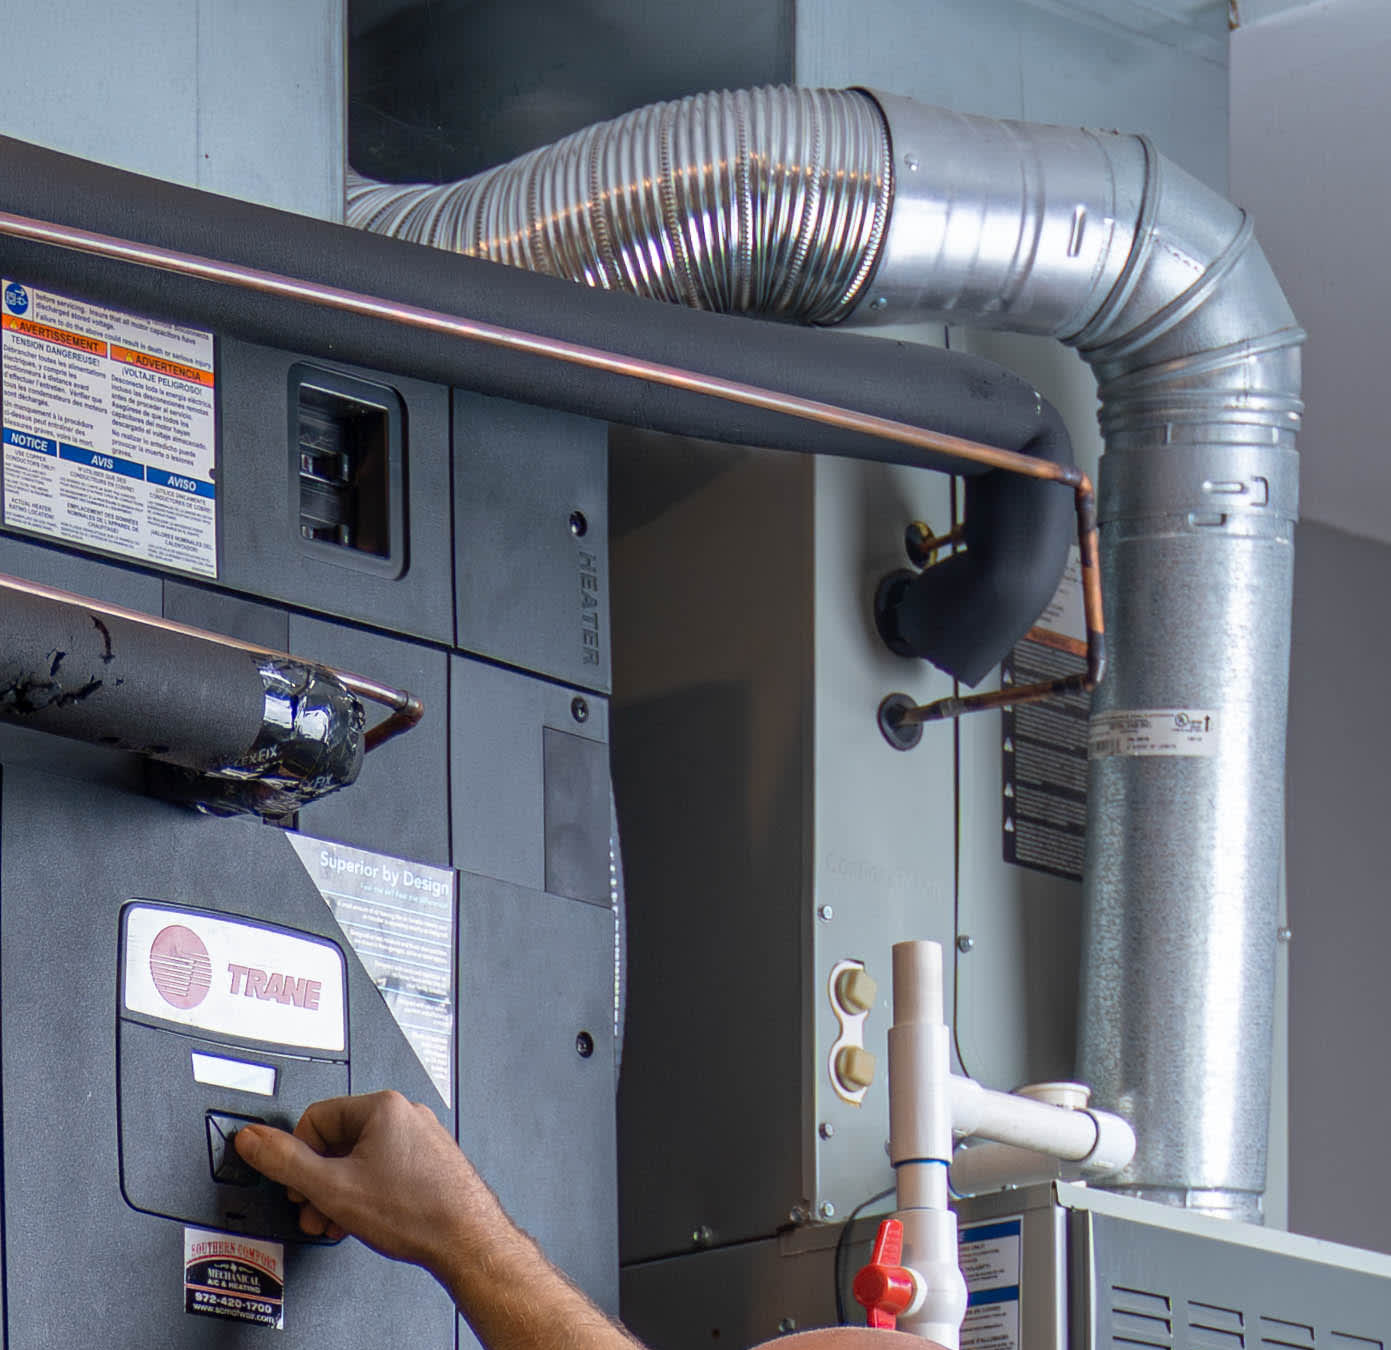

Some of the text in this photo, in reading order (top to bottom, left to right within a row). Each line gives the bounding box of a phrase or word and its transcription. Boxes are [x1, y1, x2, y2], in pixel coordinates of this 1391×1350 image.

[20, 322, 98, 352] AVERTISSEMENT
[135, 355, 201, 381] ADVERTENCIA
[10, 432, 48, 452] NOTICE
[90, 455, 115, 470] AVIS
[167, 476, 197, 492] AVISO
[579, 551, 599, 666] HEATER
[320, 850, 379, 878] Superior
[382, 864, 400, 887] by
[403, 870, 449, 897] Design
[228, 963, 322, 1011] TRANE
[191, 1240, 277, 1272] SOUTHERN COMFORT
[208, 1267, 258, 1286] MECHANICAL
[221, 1280, 227, 1288] &
[228, 1282, 261, 1294] HEATING
[195, 1292, 272, 1314] 972-420-1700
